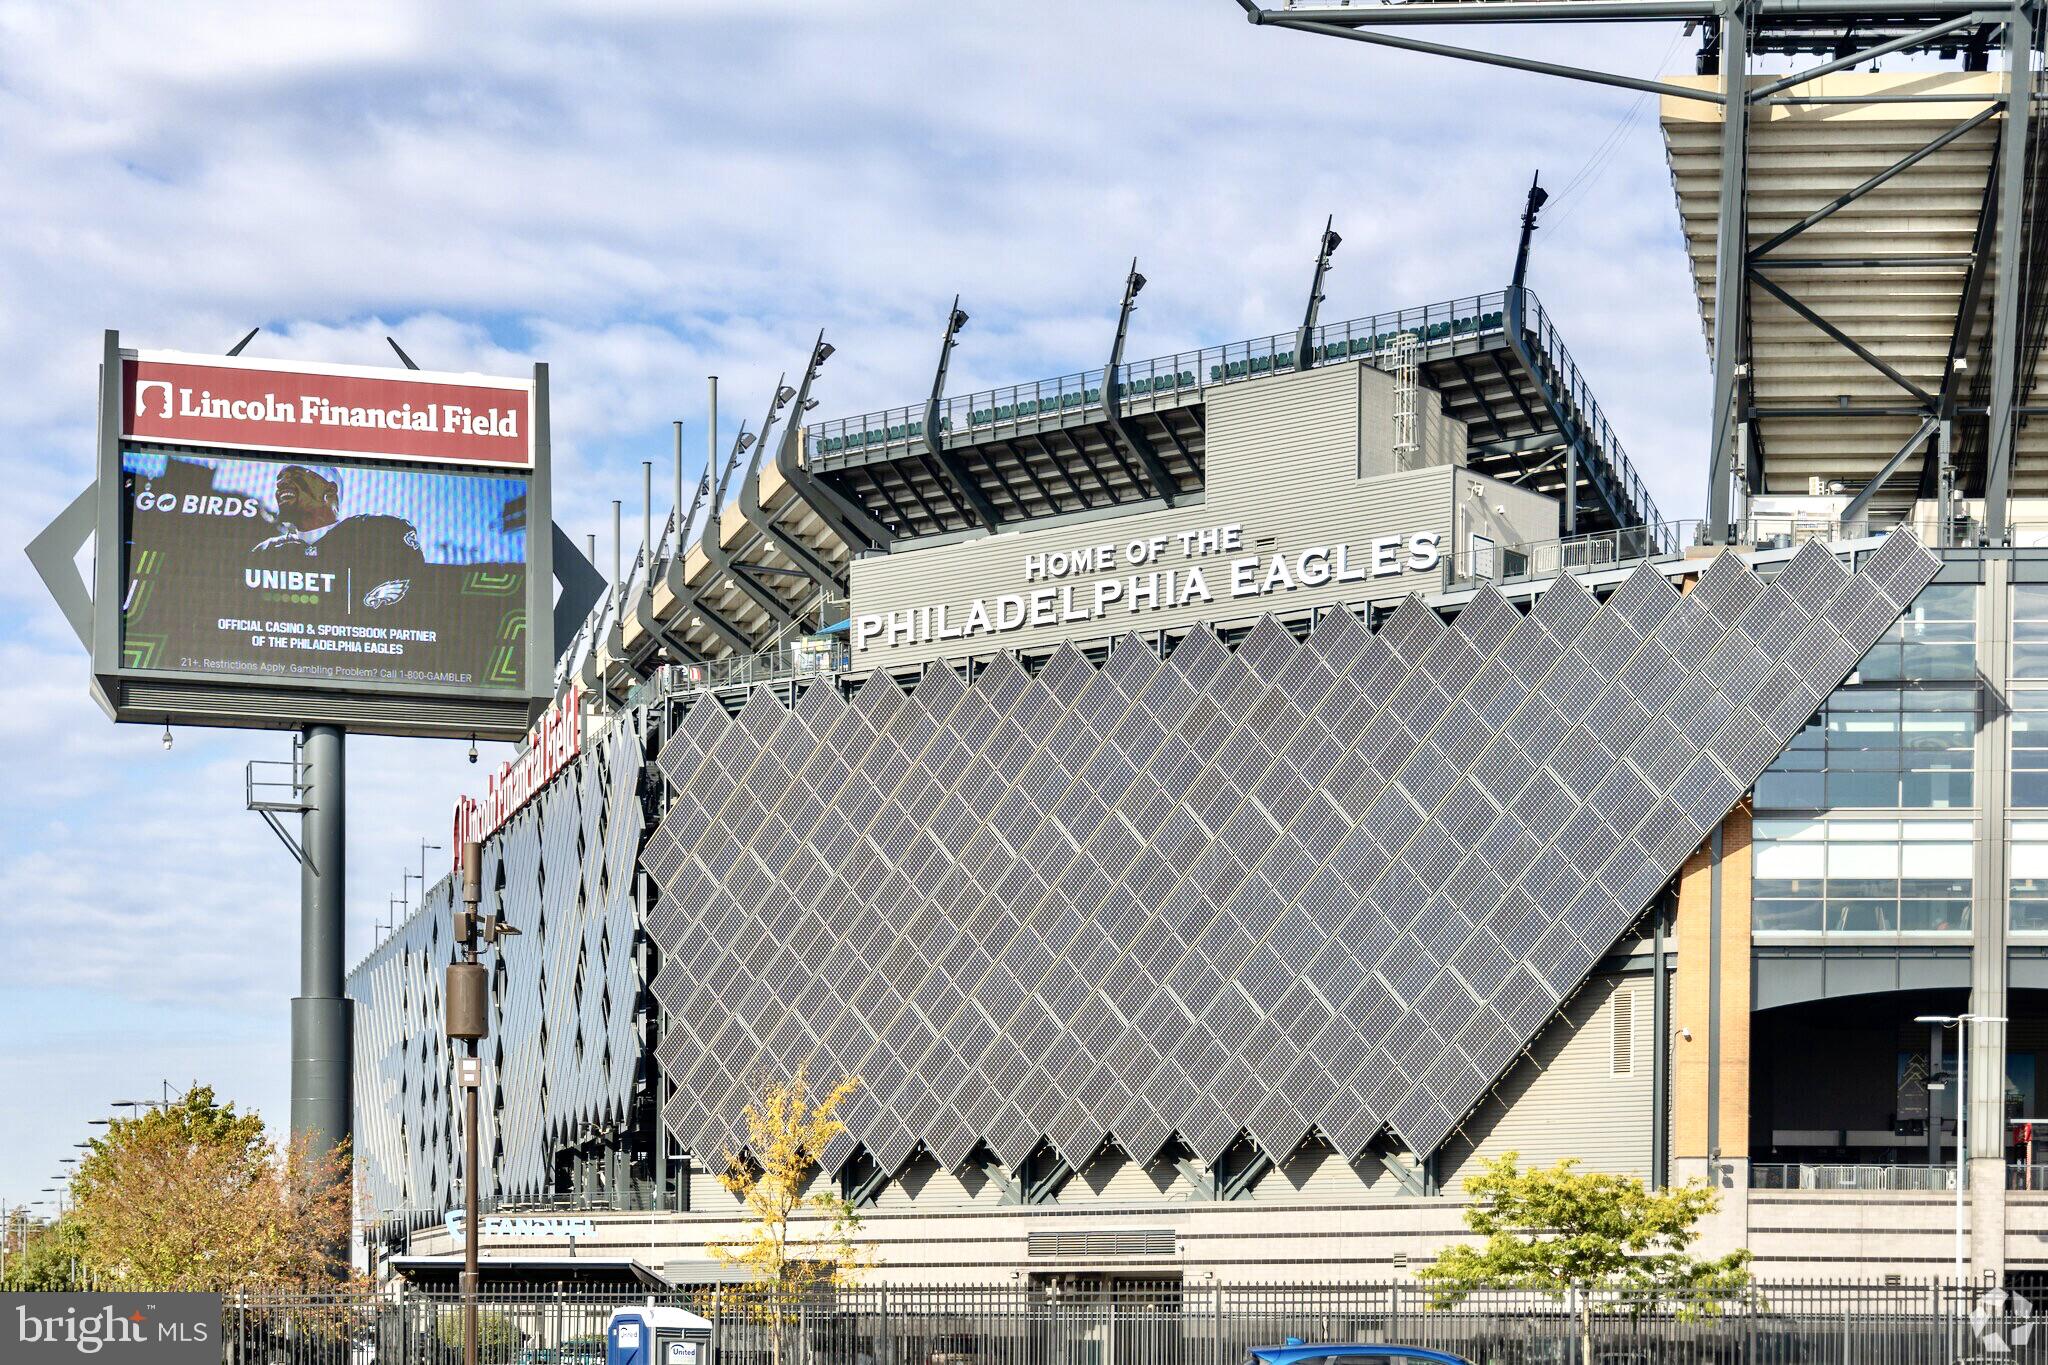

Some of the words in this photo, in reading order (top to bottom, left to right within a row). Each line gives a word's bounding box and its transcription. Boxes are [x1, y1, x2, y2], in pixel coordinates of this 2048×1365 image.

[179, 388, 296, 423] Lincoln
[300, 396, 438, 432] Financial
[443, 405, 518, 437] Field
[135, 491, 177, 512] GO
[182, 494, 259, 518] BIRDS
[1025, 544, 1117, 582] HOME
[1126, 535, 1168, 566] OF
[1177, 523, 1243, 558] THE
[245, 568, 335, 593] UNIBET
[857, 566, 1214, 651] PHILADELPHIA
[1230, 530, 1441, 598] EAGLES
[217, 618, 263, 632] OFFICIAL
[265, 621, 304, 634] CASINO
[306, 623, 315, 635] &
[317, 624, 387, 639] SPORTSBOOK
[389, 629, 436, 642] PARTNER
[251, 635, 266, 647] OF
[268, 636, 288, 648] THE
[290, 637, 362, 653] PHILADELPHIA
[364, 642, 403, 655] EAGLES
[203, 658, 258, 671] Restrictions
[290, 663, 333, 677] Gambling
[335, 666, 378, 677] Problem?
[380, 668, 397, 679] Call
[400, 670, 472, 683] 1-800-GAMBLER
[496, 714, 549, 827] Financial
[545, 684, 581, 780] Field
[485, 1217, 598, 1237] FANDUEL
[673, 1348, 696, 1356] United
